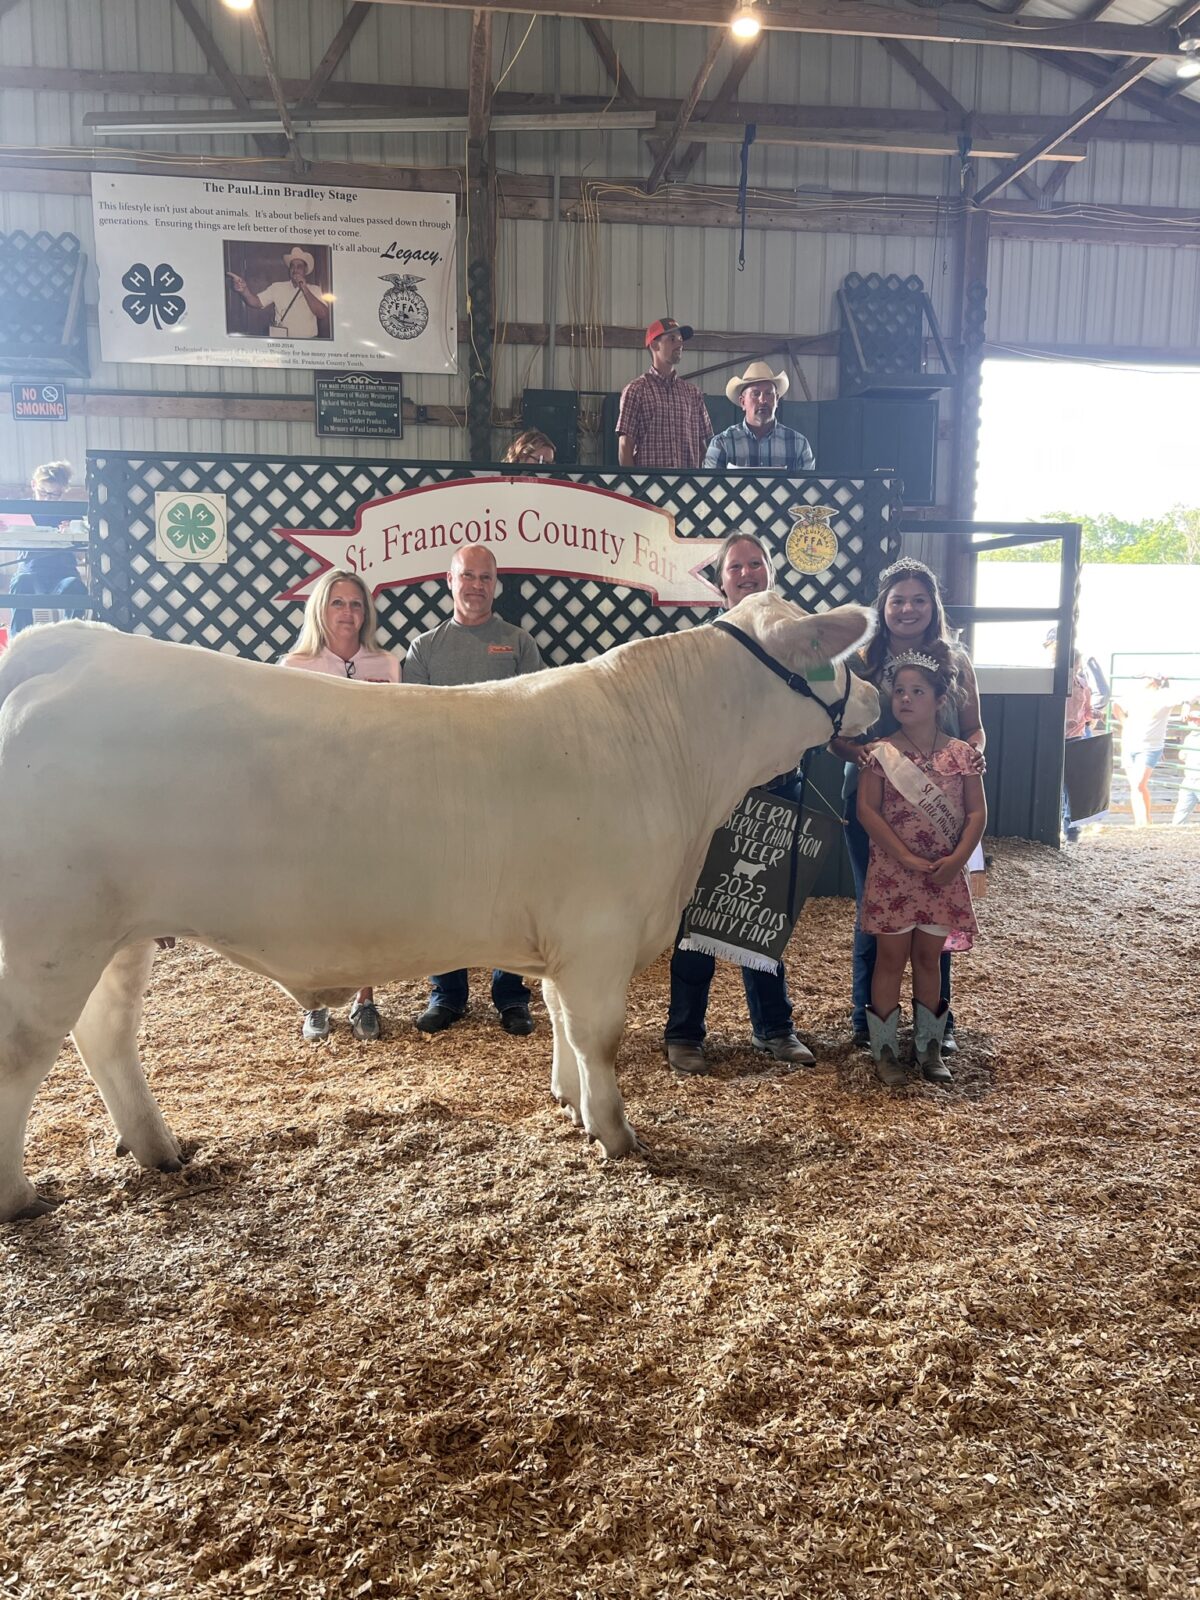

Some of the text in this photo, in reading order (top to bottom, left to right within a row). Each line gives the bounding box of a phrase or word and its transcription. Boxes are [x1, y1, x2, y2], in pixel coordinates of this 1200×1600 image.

[203, 182, 224, 192] The
[284, 187, 326, 201] Bradley
[328, 189, 358, 202] Stage
[99, 201, 451, 231] This lifestyle isn't just about animals. It's about beliefs and values passed down through
[99, 217, 149, 227] generations.
[155, 218, 193, 230] Ensuring
[194, 220, 221, 232] things
[237, 222, 251, 232] left
[253, 223, 277, 233] better
[279, 225, 288, 234] of
[290, 226, 312, 235] those
[314, 228, 326, 237] yet
[328, 228, 336, 236] to
[338, 230, 362, 238] come.
[332, 242, 442, 266] It's all about Legacy.
[396, 303, 414, 312] FFA
[22, 387, 36, 400] NO
[16, 402, 64, 416] SMOKING
[346, 508, 678, 584] St. Francois County Fair
[804, 536, 822, 546] FFA
[918, 798, 938, 818] Little
[936, 816, 950, 836] Miss
[730, 834, 785, 868] STEER
[714, 873, 766, 903] 2023
[708, 892, 787, 931] FRANCOIS
[739, 921, 777, 948] FAIR
